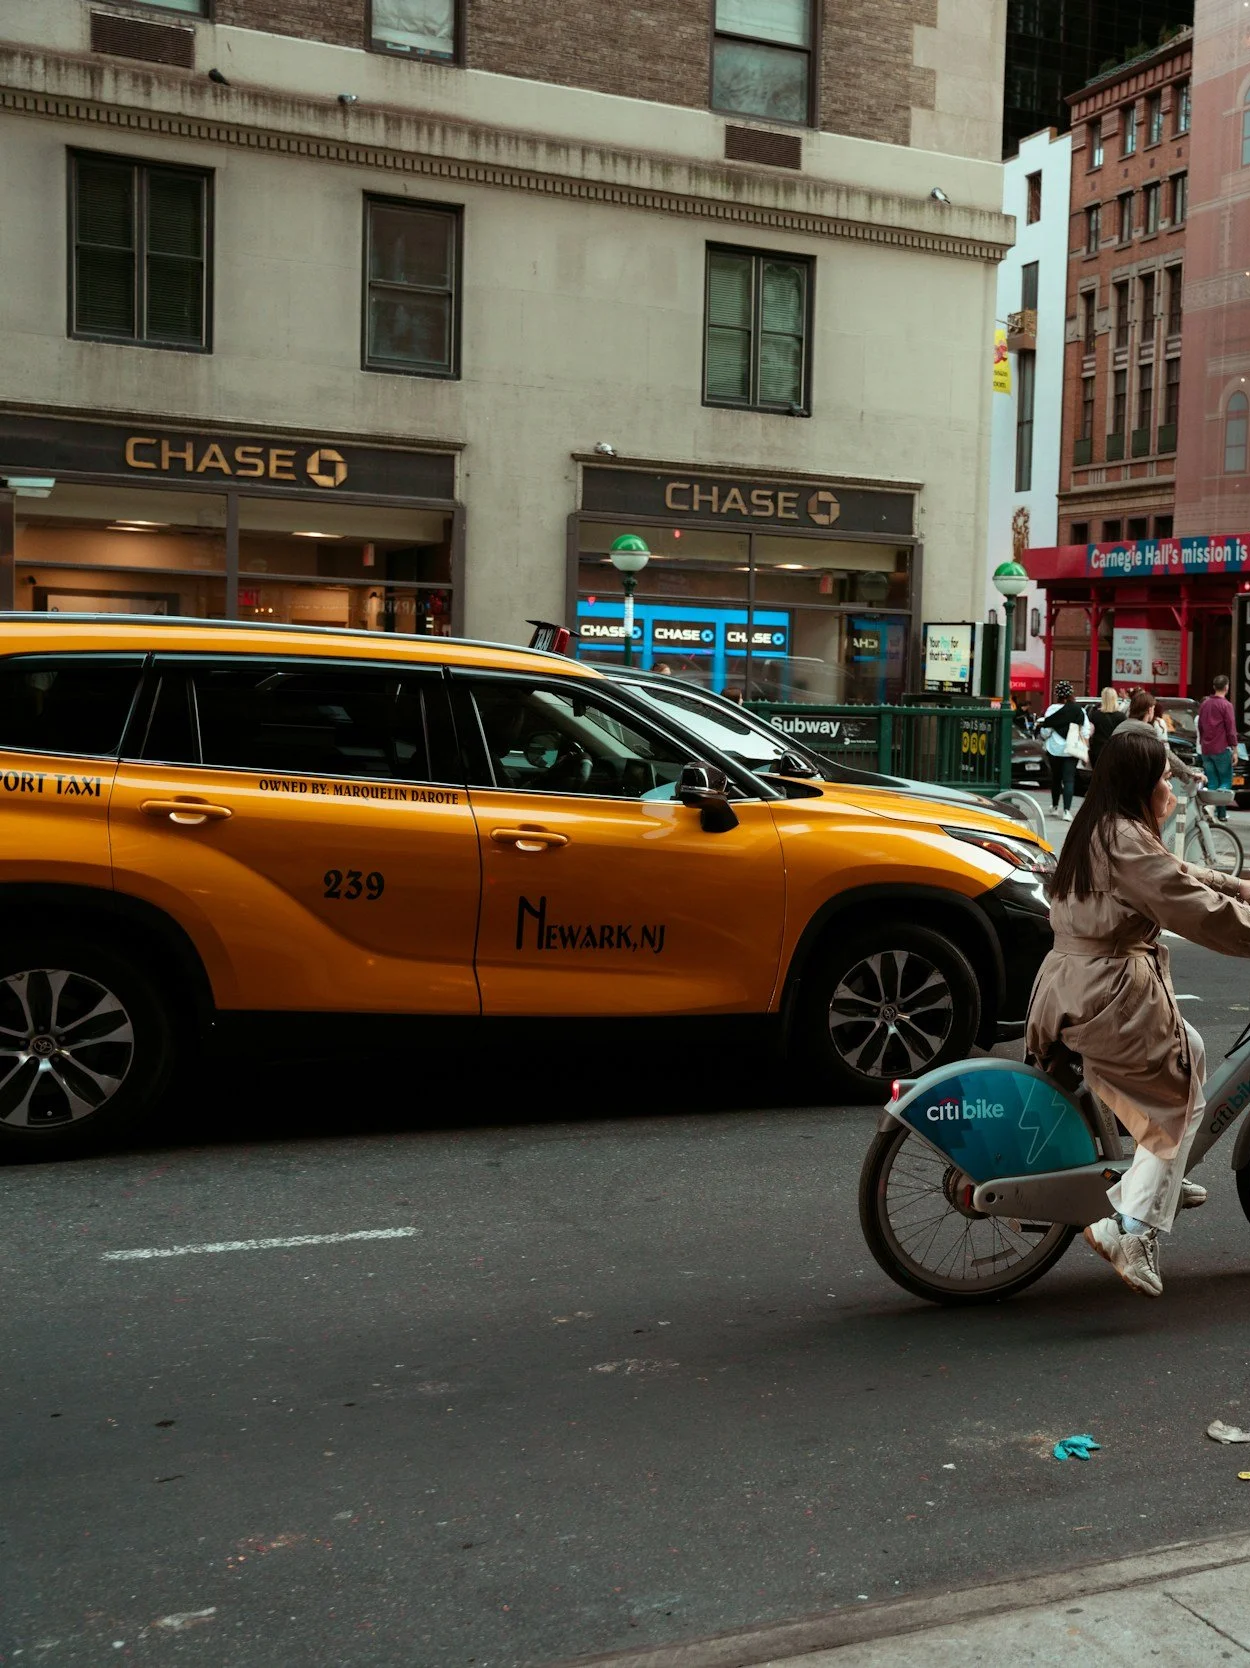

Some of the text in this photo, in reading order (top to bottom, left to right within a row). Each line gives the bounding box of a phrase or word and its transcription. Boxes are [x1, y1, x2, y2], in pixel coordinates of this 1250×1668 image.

[125, 436, 298, 482] CHASE
[664, 482, 800, 520] CHASE
[1091, 547, 1142, 572] Carnegie
[1182, 541, 1232, 564] mission
[1236, 538, 1248, 561] is
[580, 625, 626, 638] CHASE
[654, 628, 700, 640] CHASE
[770, 716, 840, 738] Subway
[0, 771, 101, 796] ORT TAXI
[259, 780, 459, 804] OWNED BY: MARQUELIN DAROTE
[323, 868, 385, 902] 239
[926, 1098, 1004, 1122] citi bike
[1210, 1106, 1234, 1134] citi
